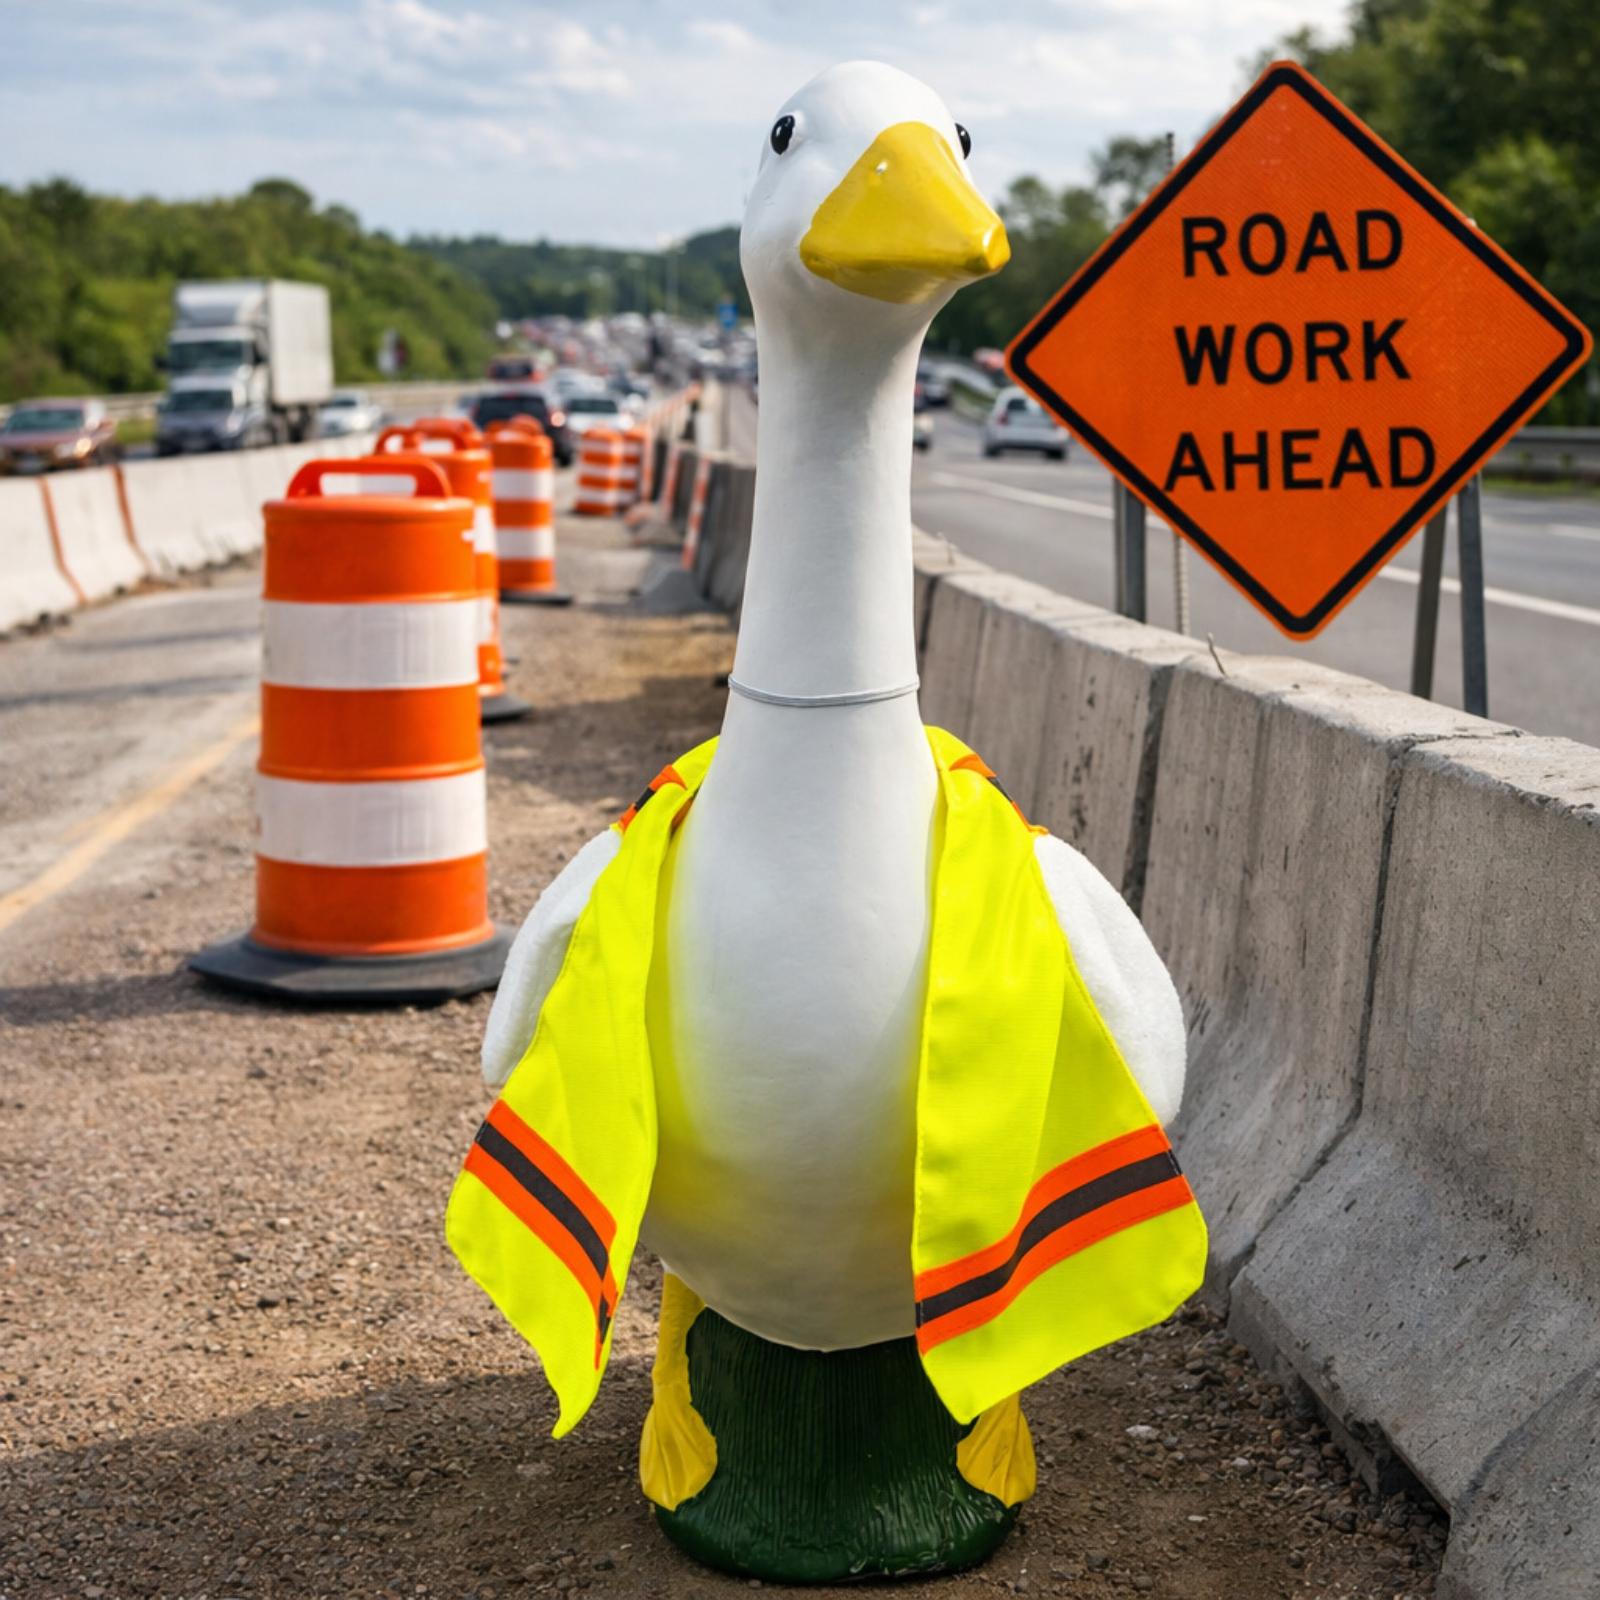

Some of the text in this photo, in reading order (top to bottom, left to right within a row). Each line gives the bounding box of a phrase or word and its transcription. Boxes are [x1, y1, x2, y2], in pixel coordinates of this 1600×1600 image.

[1181, 209, 1403, 277] ROAD
[1174, 319, 1411, 386] WORK
[1164, 427, 1436, 492] AHEAD
